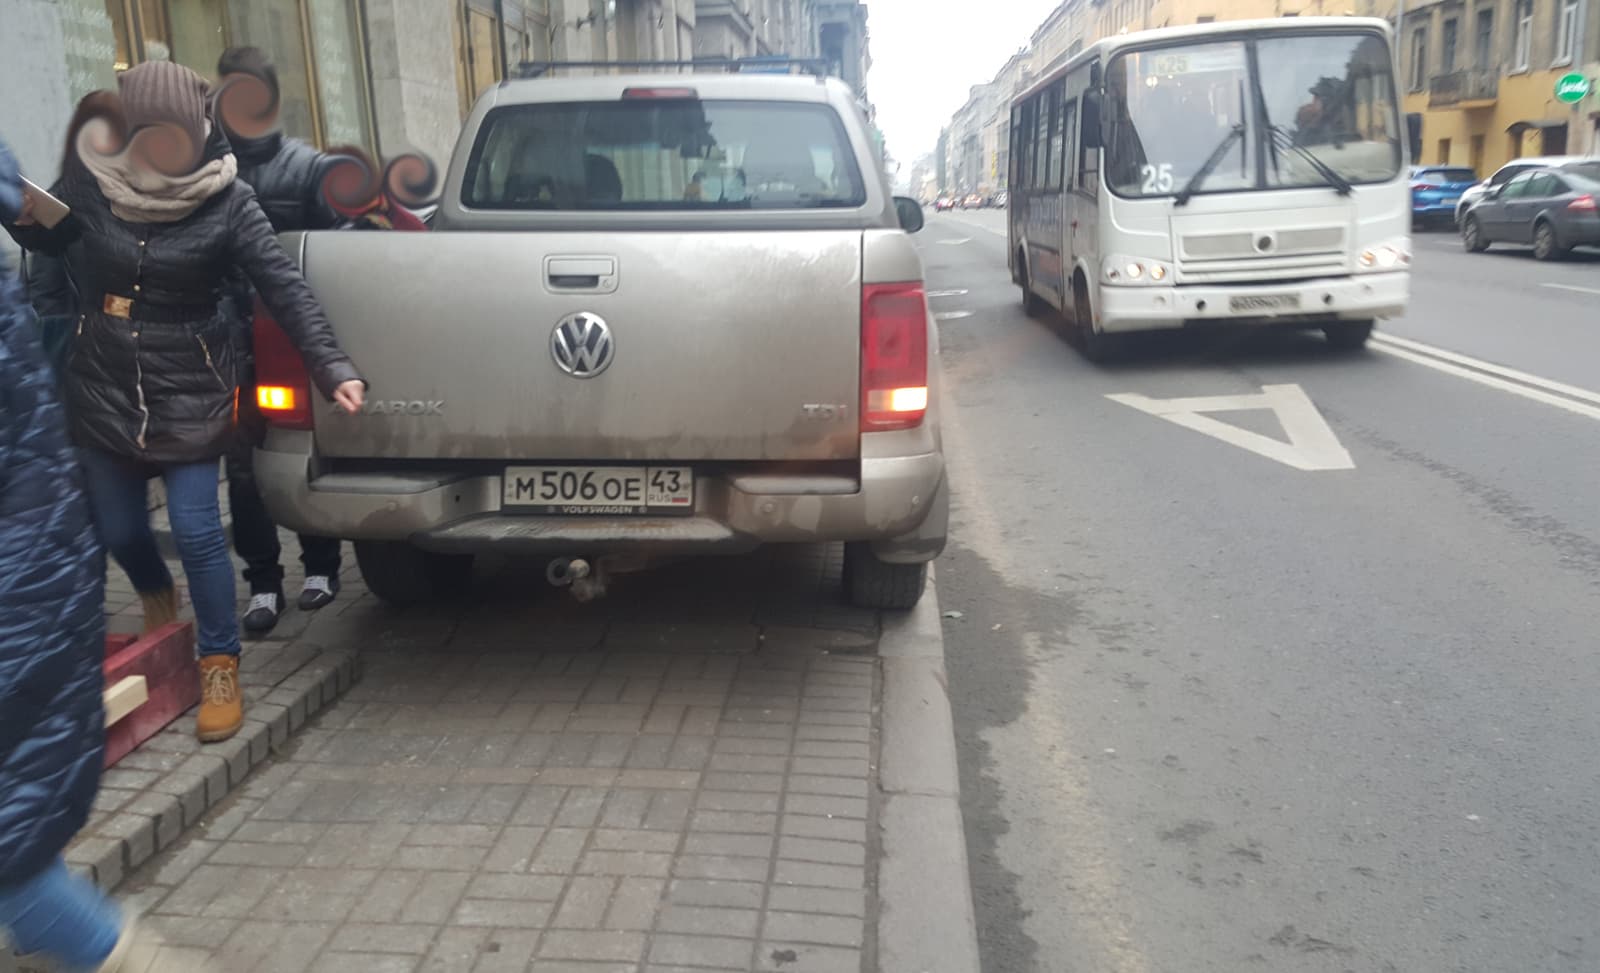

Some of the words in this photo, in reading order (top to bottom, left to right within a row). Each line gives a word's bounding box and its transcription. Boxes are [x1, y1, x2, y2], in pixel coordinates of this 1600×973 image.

[1141, 164, 1174, 194] 25
[651, 470, 681, 493] 43
[649, 493, 671, 503] RUS
[562, 505, 633, 514] VOLKSWAGEN
